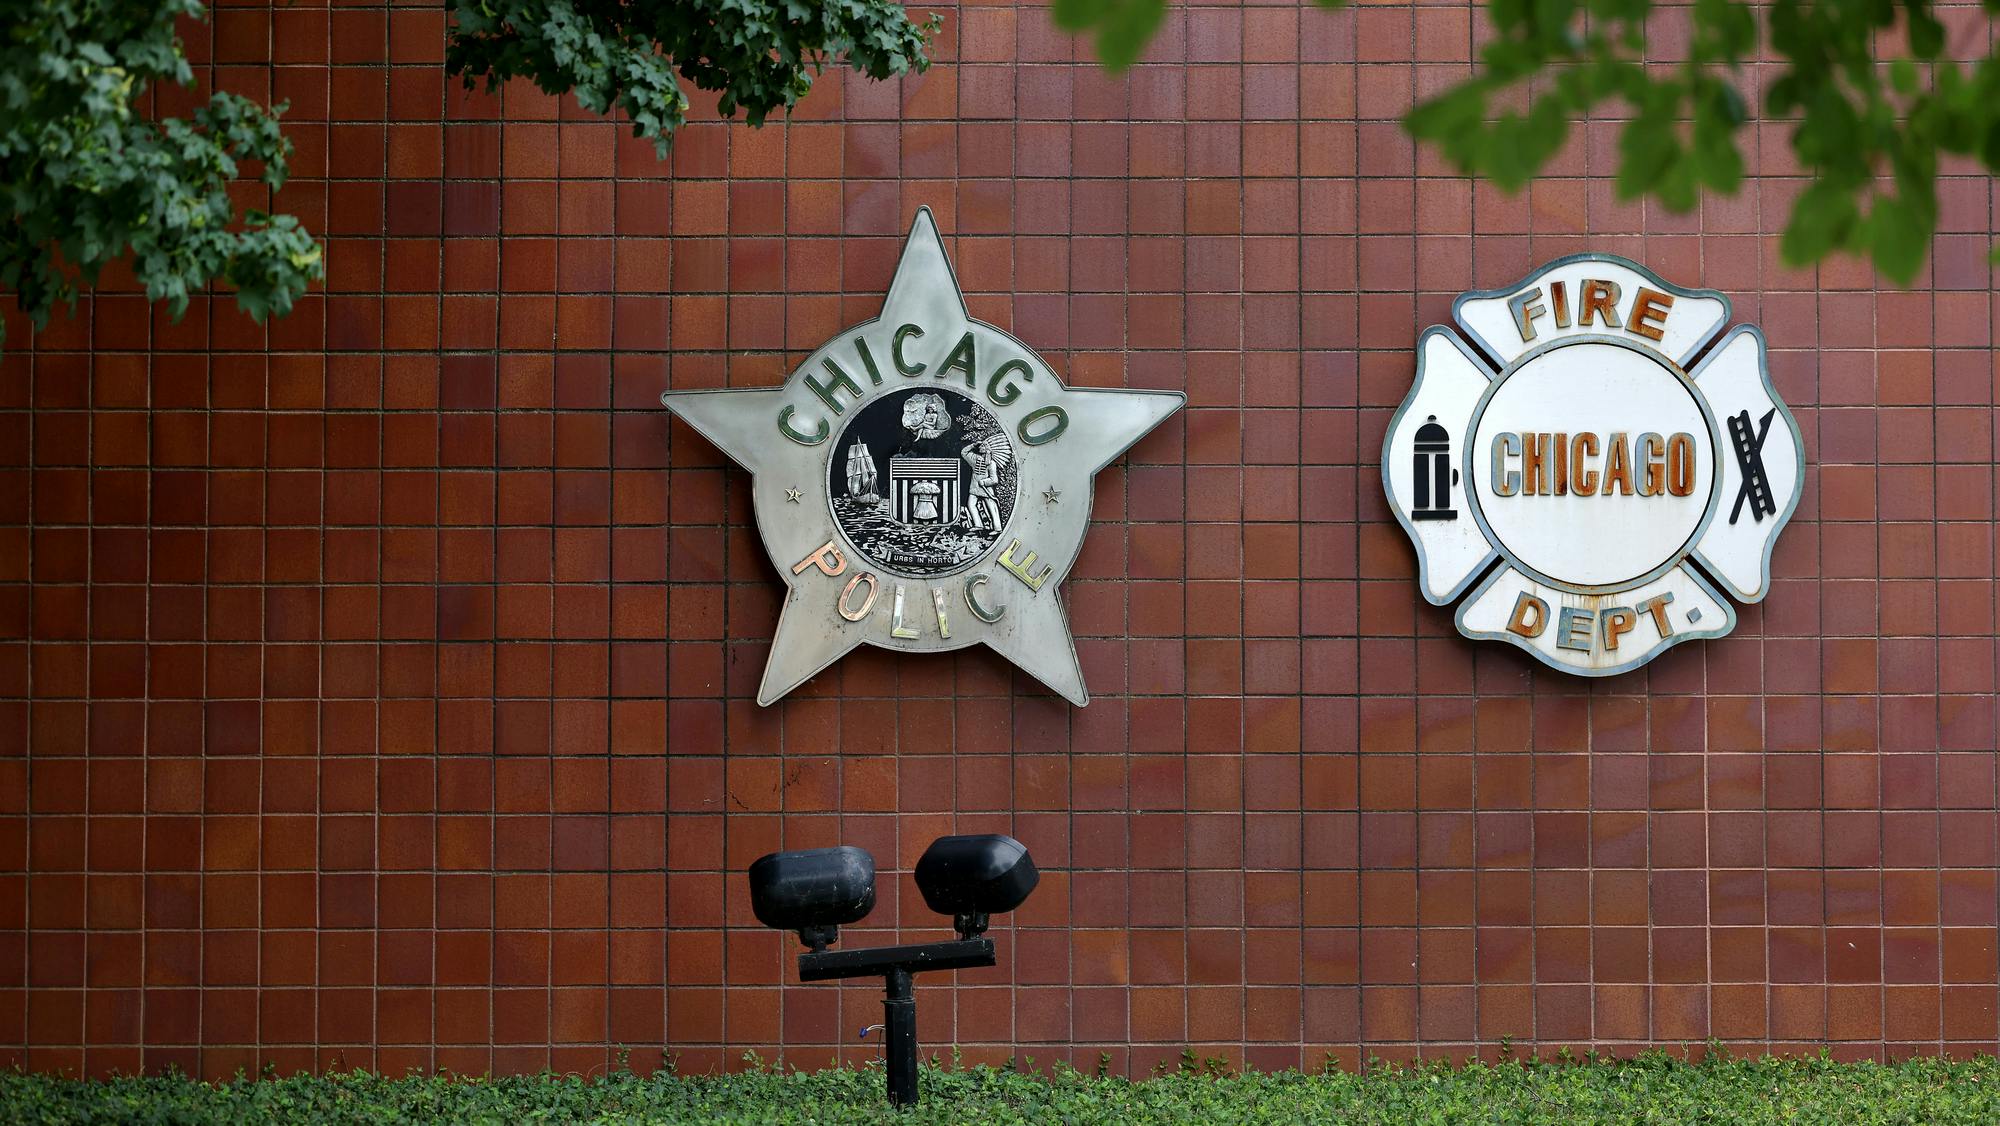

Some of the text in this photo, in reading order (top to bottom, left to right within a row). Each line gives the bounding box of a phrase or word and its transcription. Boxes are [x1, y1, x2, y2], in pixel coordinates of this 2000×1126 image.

[1507, 278, 1675, 343] FIRE
[778, 323, 1070, 446] CHICAGO
[1490, 431, 1697, 497] CHICAGO
[791, 538, 1054, 640] POLICE
[893, 555, 951, 564] URBS IN HORTO
[1505, 590, 1702, 652] DEPT.
